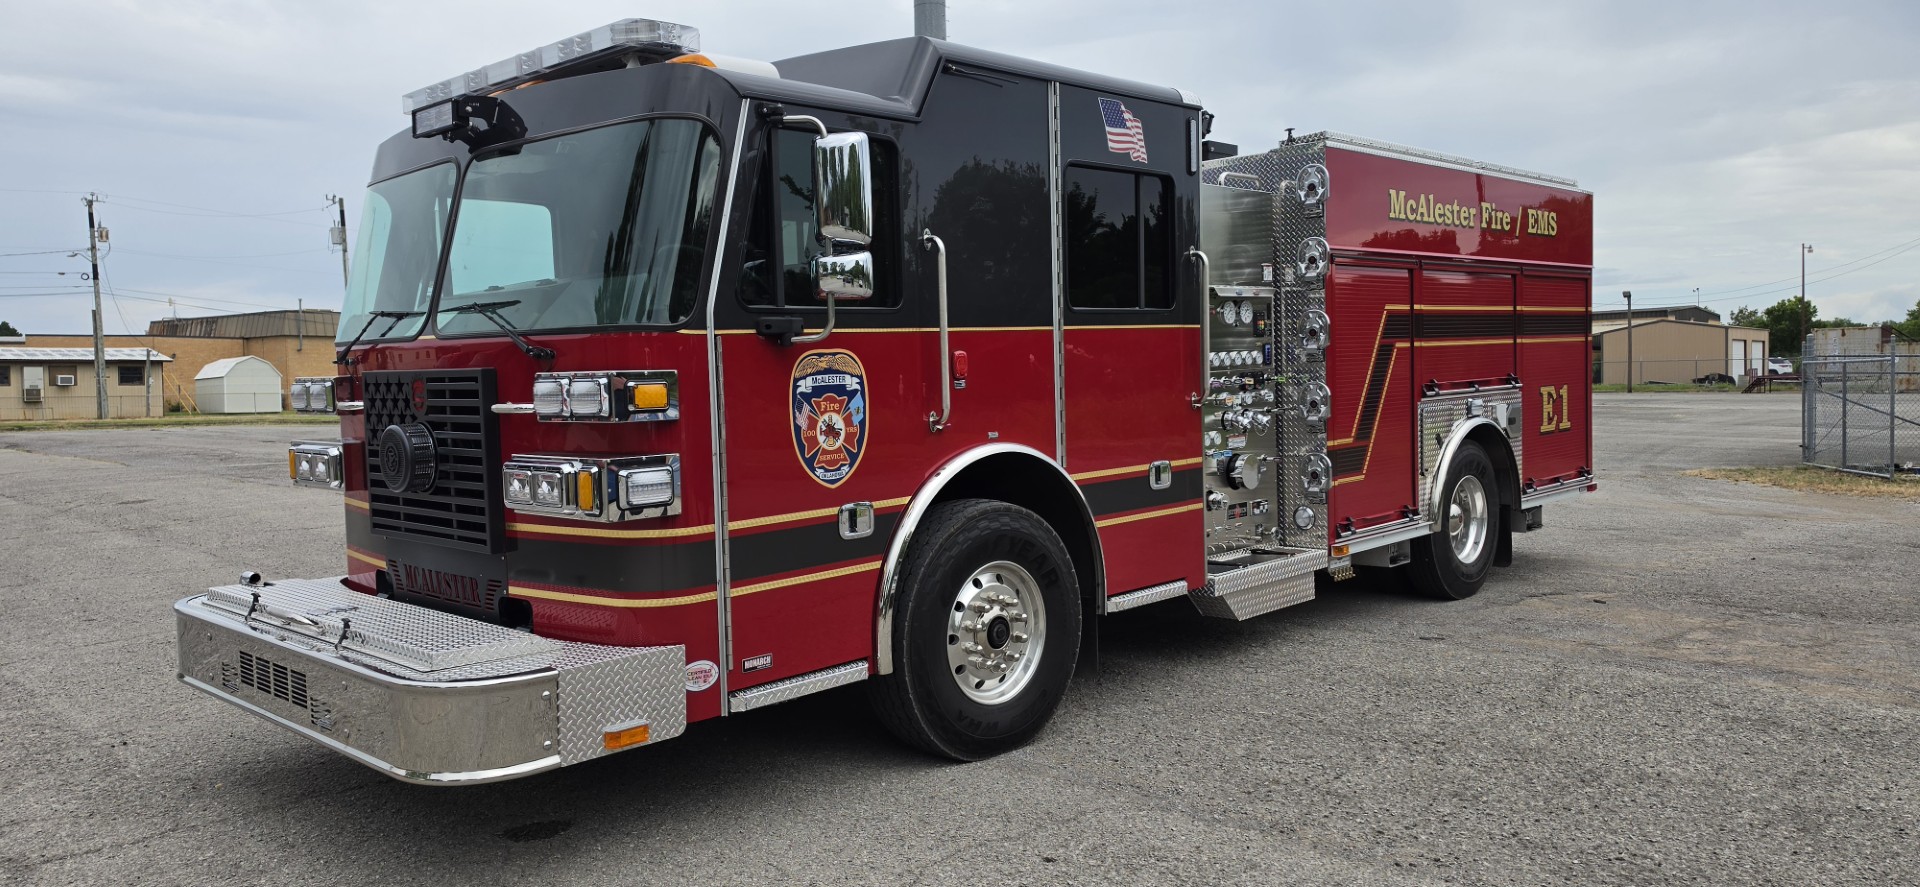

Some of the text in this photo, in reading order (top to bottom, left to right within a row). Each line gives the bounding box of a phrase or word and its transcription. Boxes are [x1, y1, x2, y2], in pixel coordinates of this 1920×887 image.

[1388, 188, 1558, 238] McAlester Fire / EMS
[811, 375, 847, 385] McALESTER
[820, 401, 840, 411] Fire
[1540, 384, 1571, 434] E1
[803, 430, 816, 438] 100
[819, 453, 845, 461] SERVICE
[744, 655, 771, 670] MONARCH
